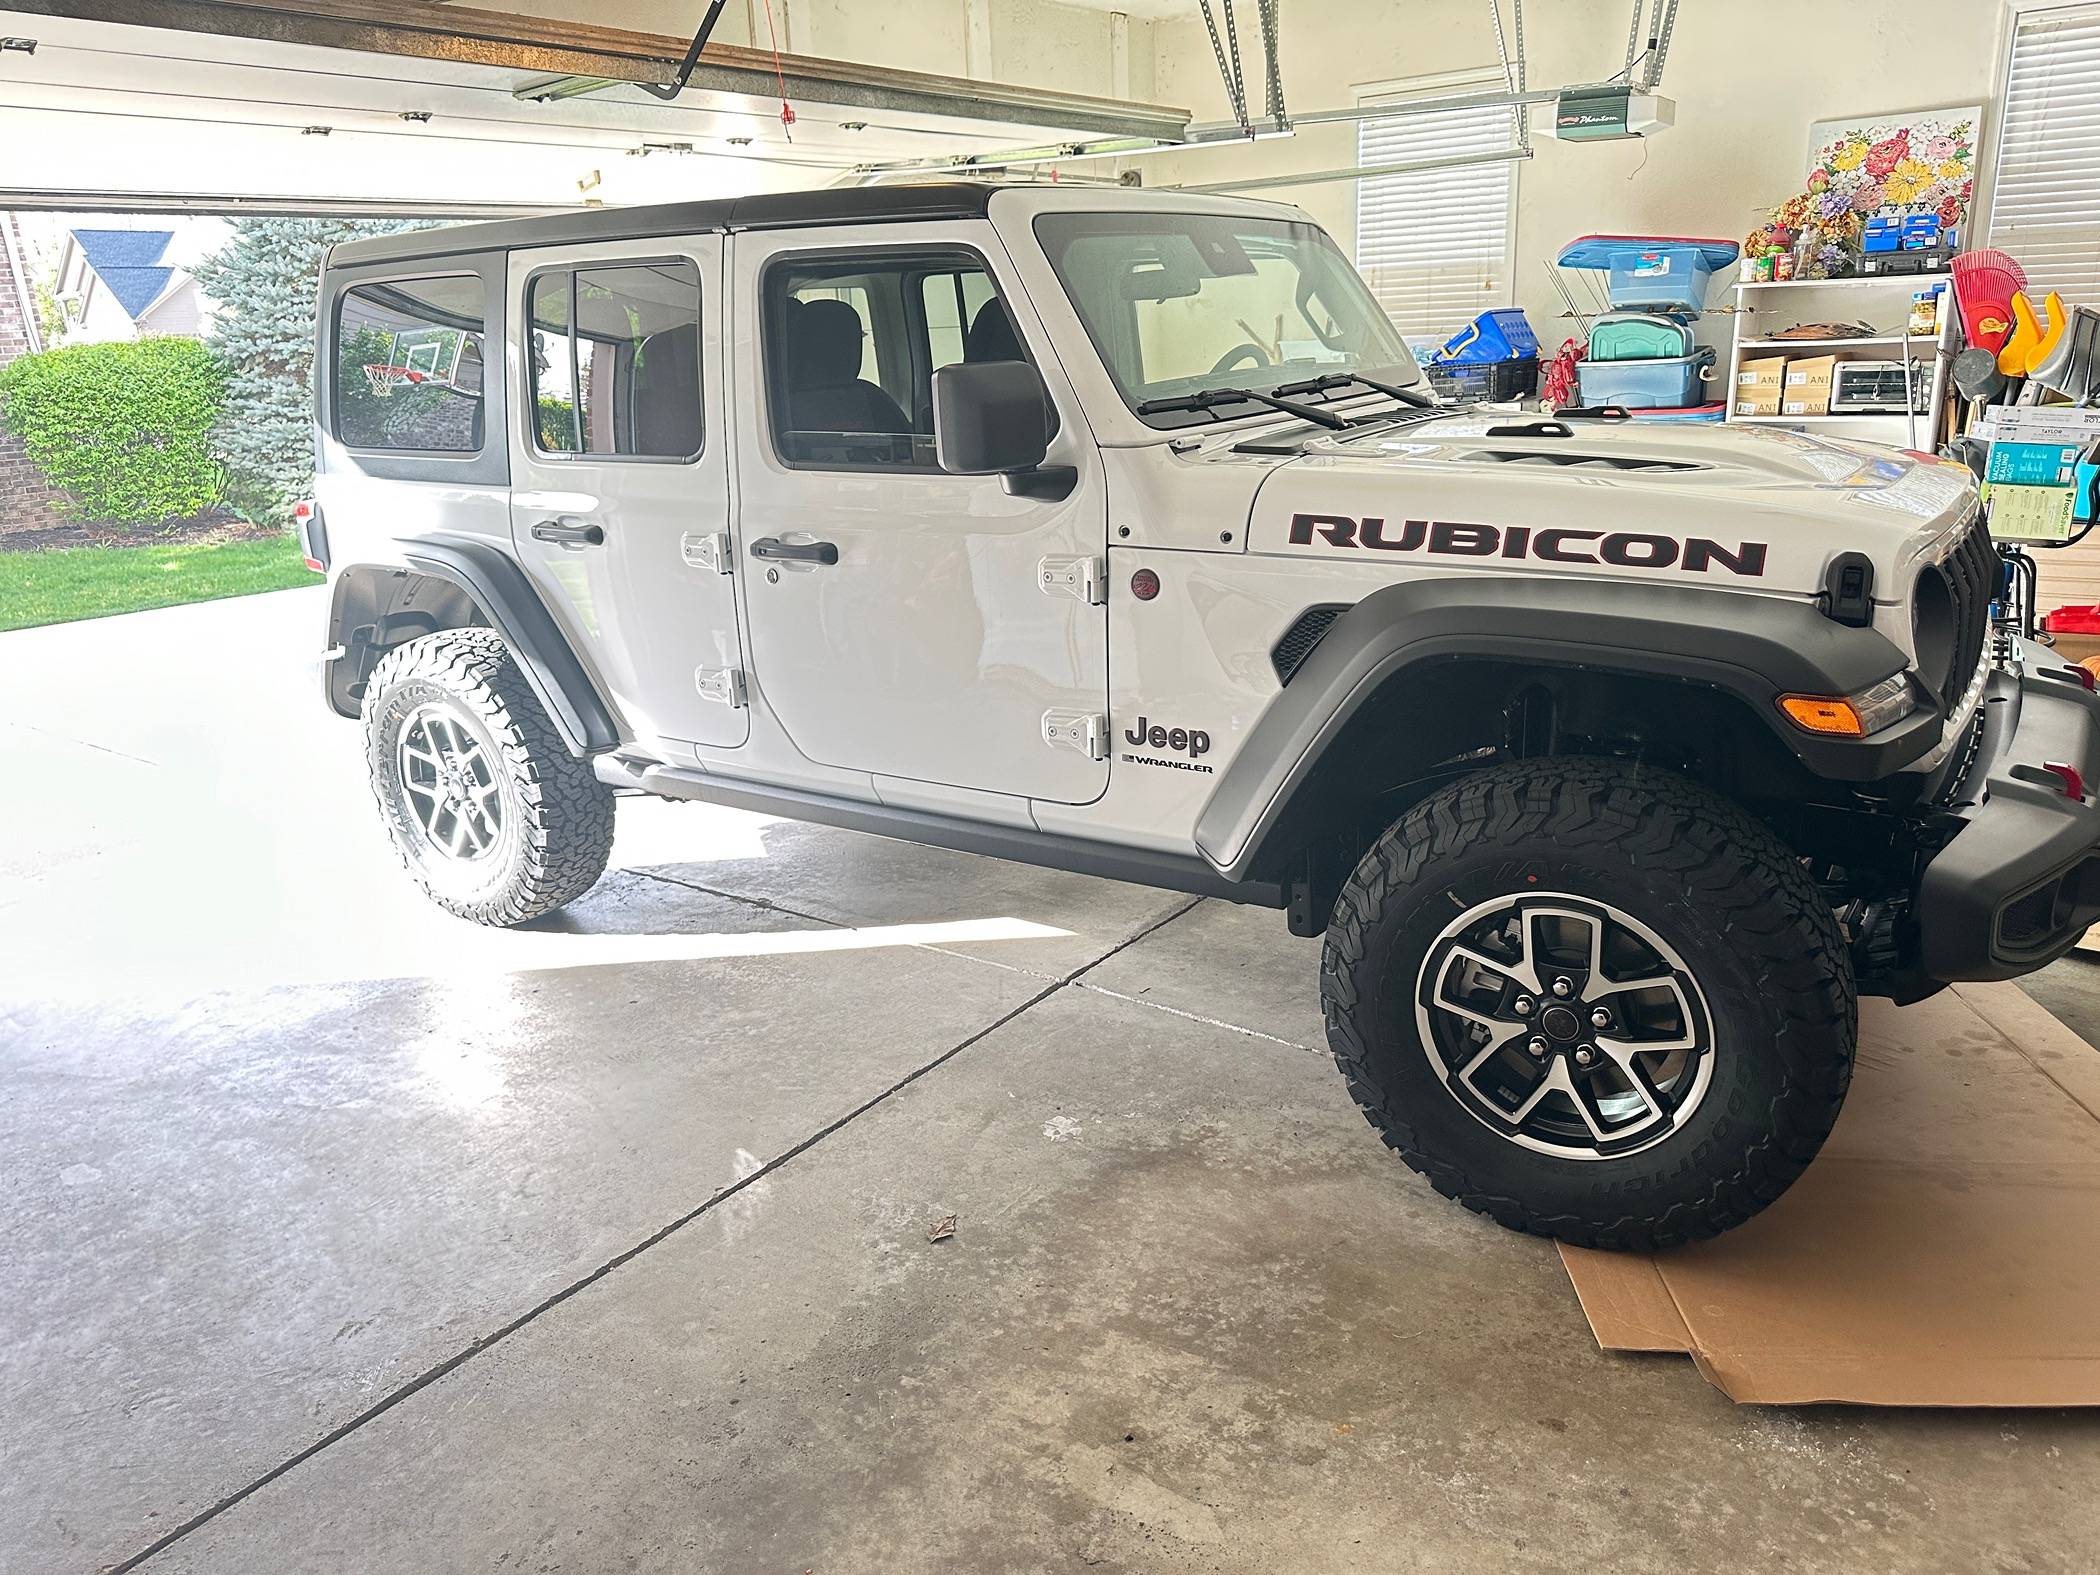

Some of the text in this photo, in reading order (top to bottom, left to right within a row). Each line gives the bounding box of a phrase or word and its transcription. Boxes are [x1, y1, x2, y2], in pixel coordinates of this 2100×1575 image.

[1580, 115, 1619, 124] Phantom
[1992, 451, 2003, 481] VACUUM
[1999, 453, 2010, 481] SEALING
[2005, 463, 2015, 482] BAGS
[2058, 499, 2072, 534] FoodSaver
[1288, 513, 1768, 577] RUBICON
[1125, 716, 1211, 758] Jeep
[1134, 755, 1213, 774] WRANGLER
